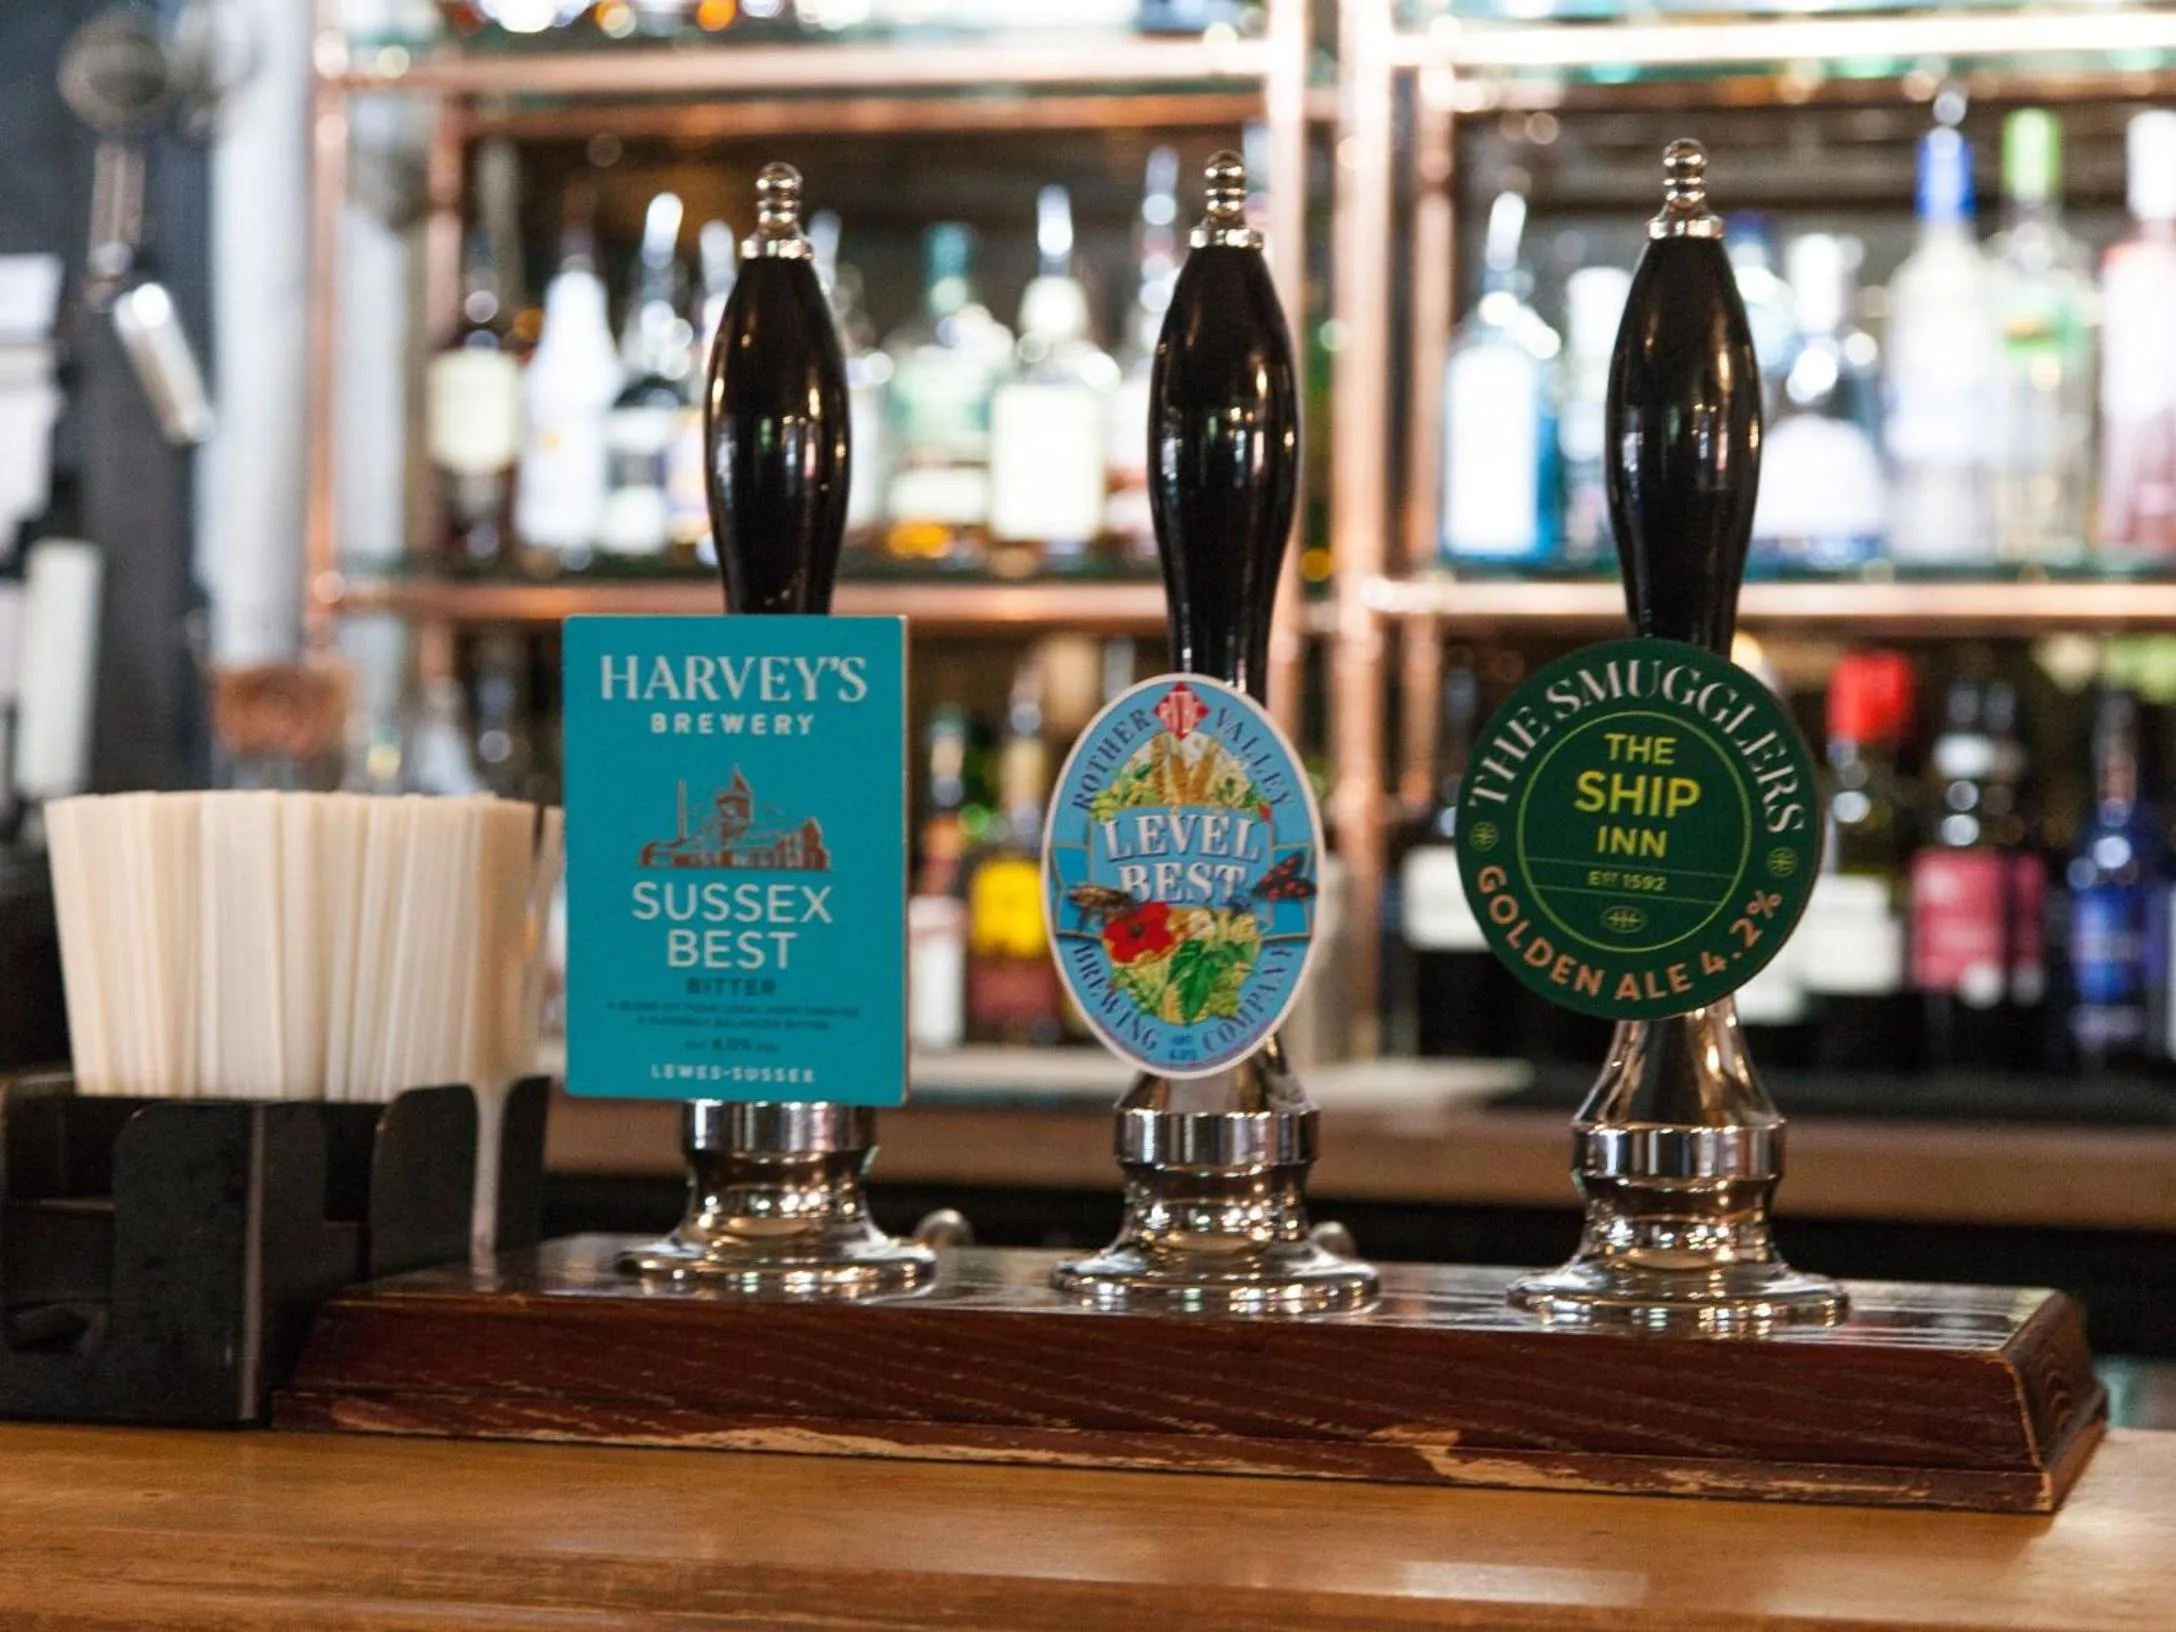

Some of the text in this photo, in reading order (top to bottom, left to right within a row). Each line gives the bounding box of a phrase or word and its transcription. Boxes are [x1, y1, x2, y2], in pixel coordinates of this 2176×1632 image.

[601, 654, 868, 703] HARVEY'S
[651, 712, 815, 735] BREWERY
[1468, 659, 1805, 834] THE SMUGGLERS
[1072, 707, 1293, 810] ROTHER VALLEY
[1604, 733, 1677, 765] THE
[1573, 770, 1700, 819] SHIP
[1102, 814, 1261, 862] LEVEL
[1597, 825, 1668, 858] INN
[632, 881, 833, 924] SUSSEX
[1118, 861, 1248, 906] BEST
[668, 929, 797, 970] BEST
[1476, 866, 1784, 1001] GOLDEN ALE 4.2%
[686, 976, 776, 996] BITTER
[1073, 943, 1293, 1051] BREWING COMPANY
